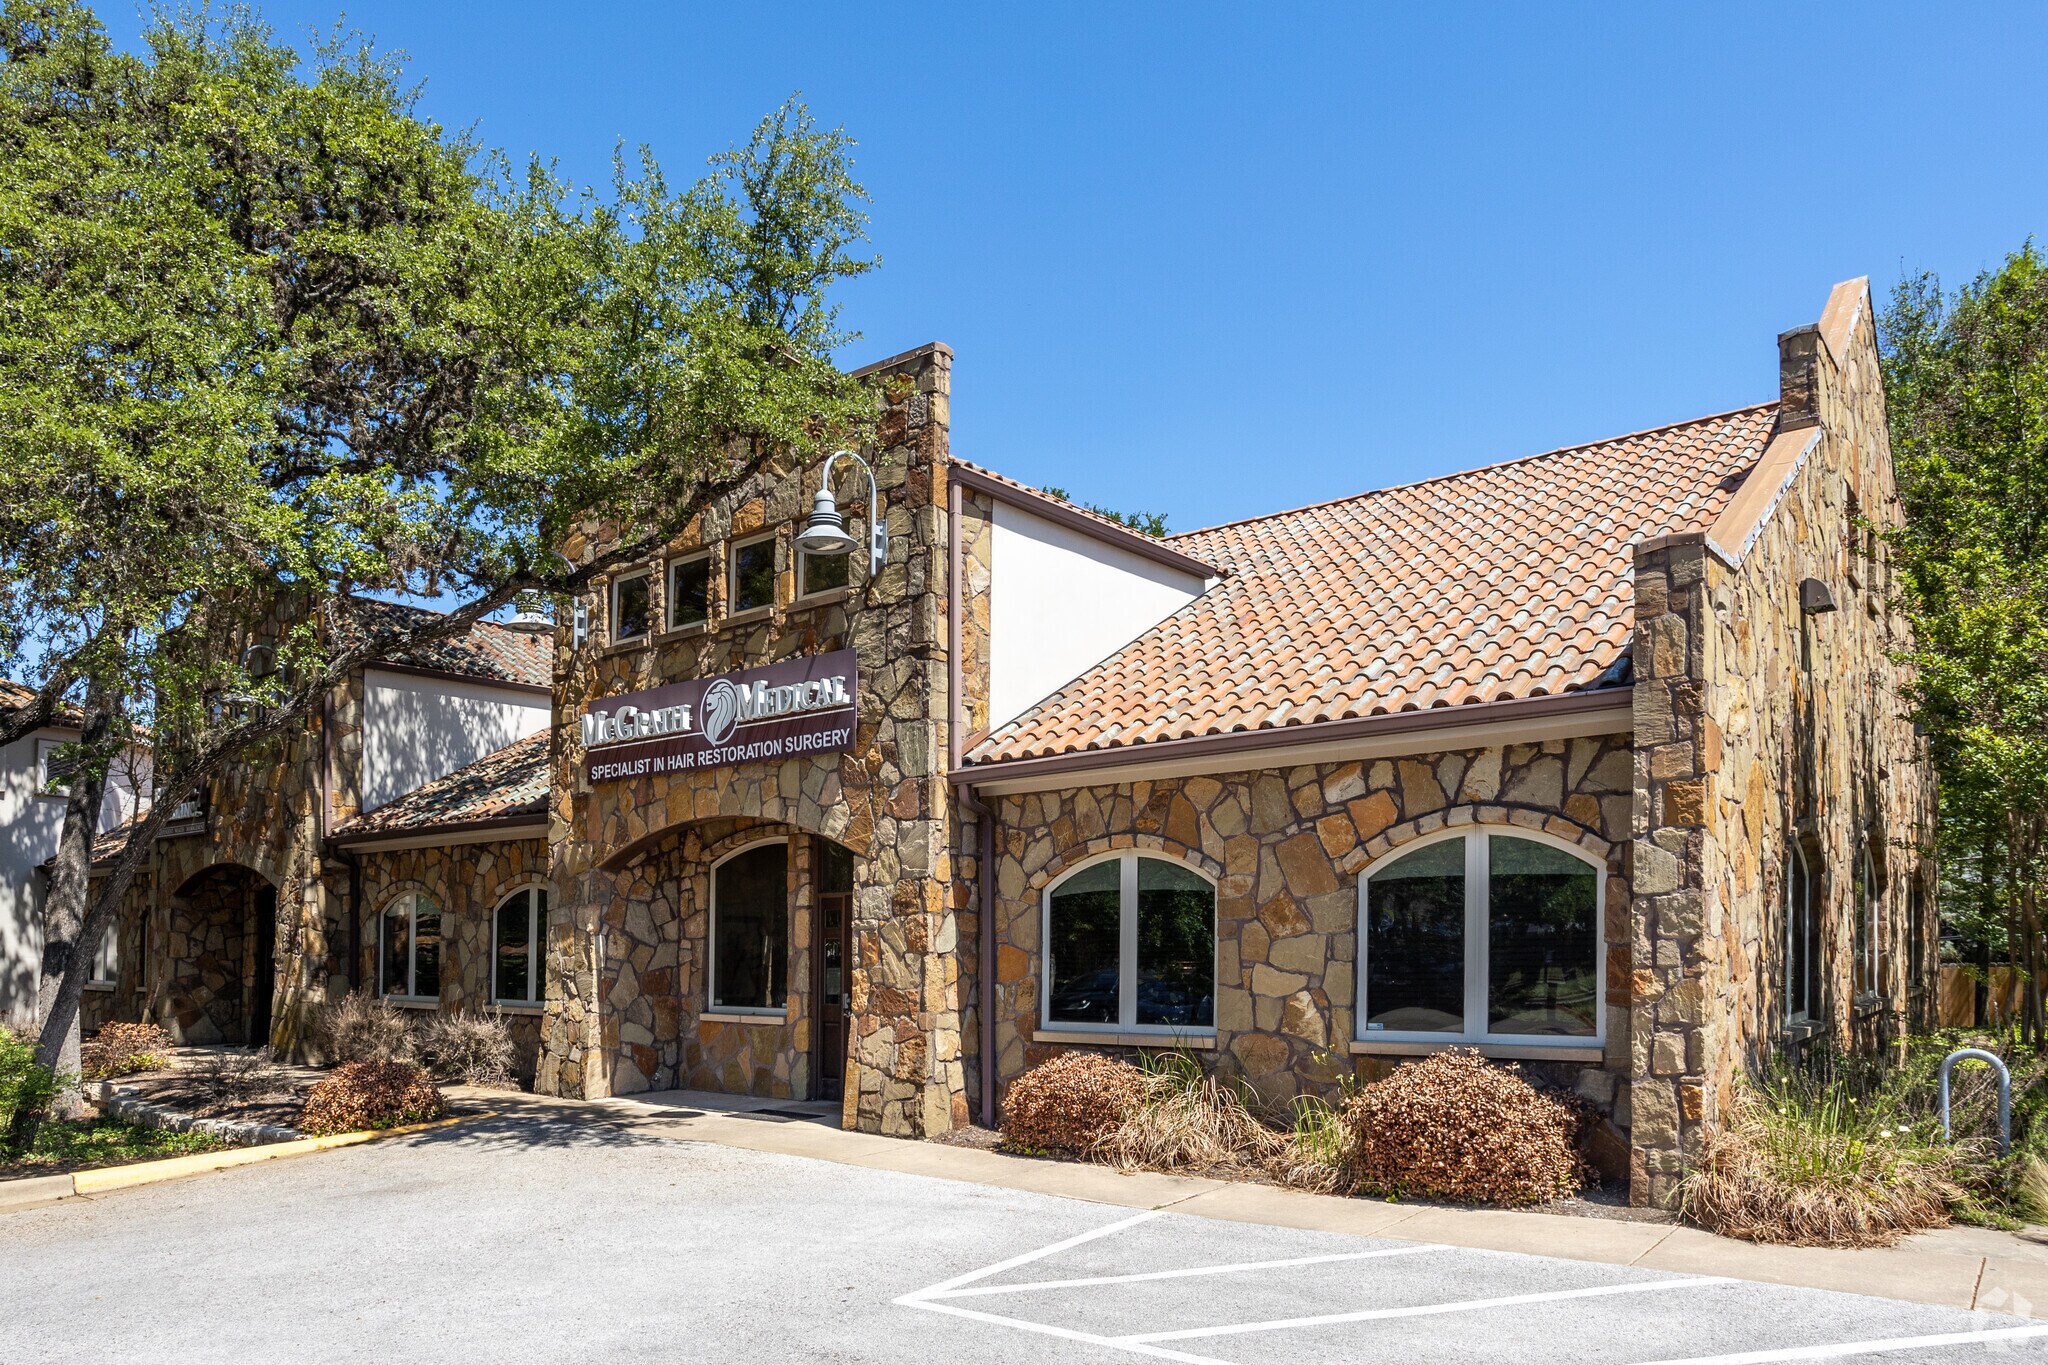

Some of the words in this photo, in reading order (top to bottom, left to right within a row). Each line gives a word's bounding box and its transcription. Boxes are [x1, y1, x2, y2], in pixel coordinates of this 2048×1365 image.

[734, 675, 852, 722] MEDICAL
[591, 758, 651, 780] SPECIALIST
[654, 757, 664, 772] IN
[667, 753, 694, 770] HAIR
[698, 739, 782, 766] RESTORATION
[785, 728, 850, 751] SURGERY
